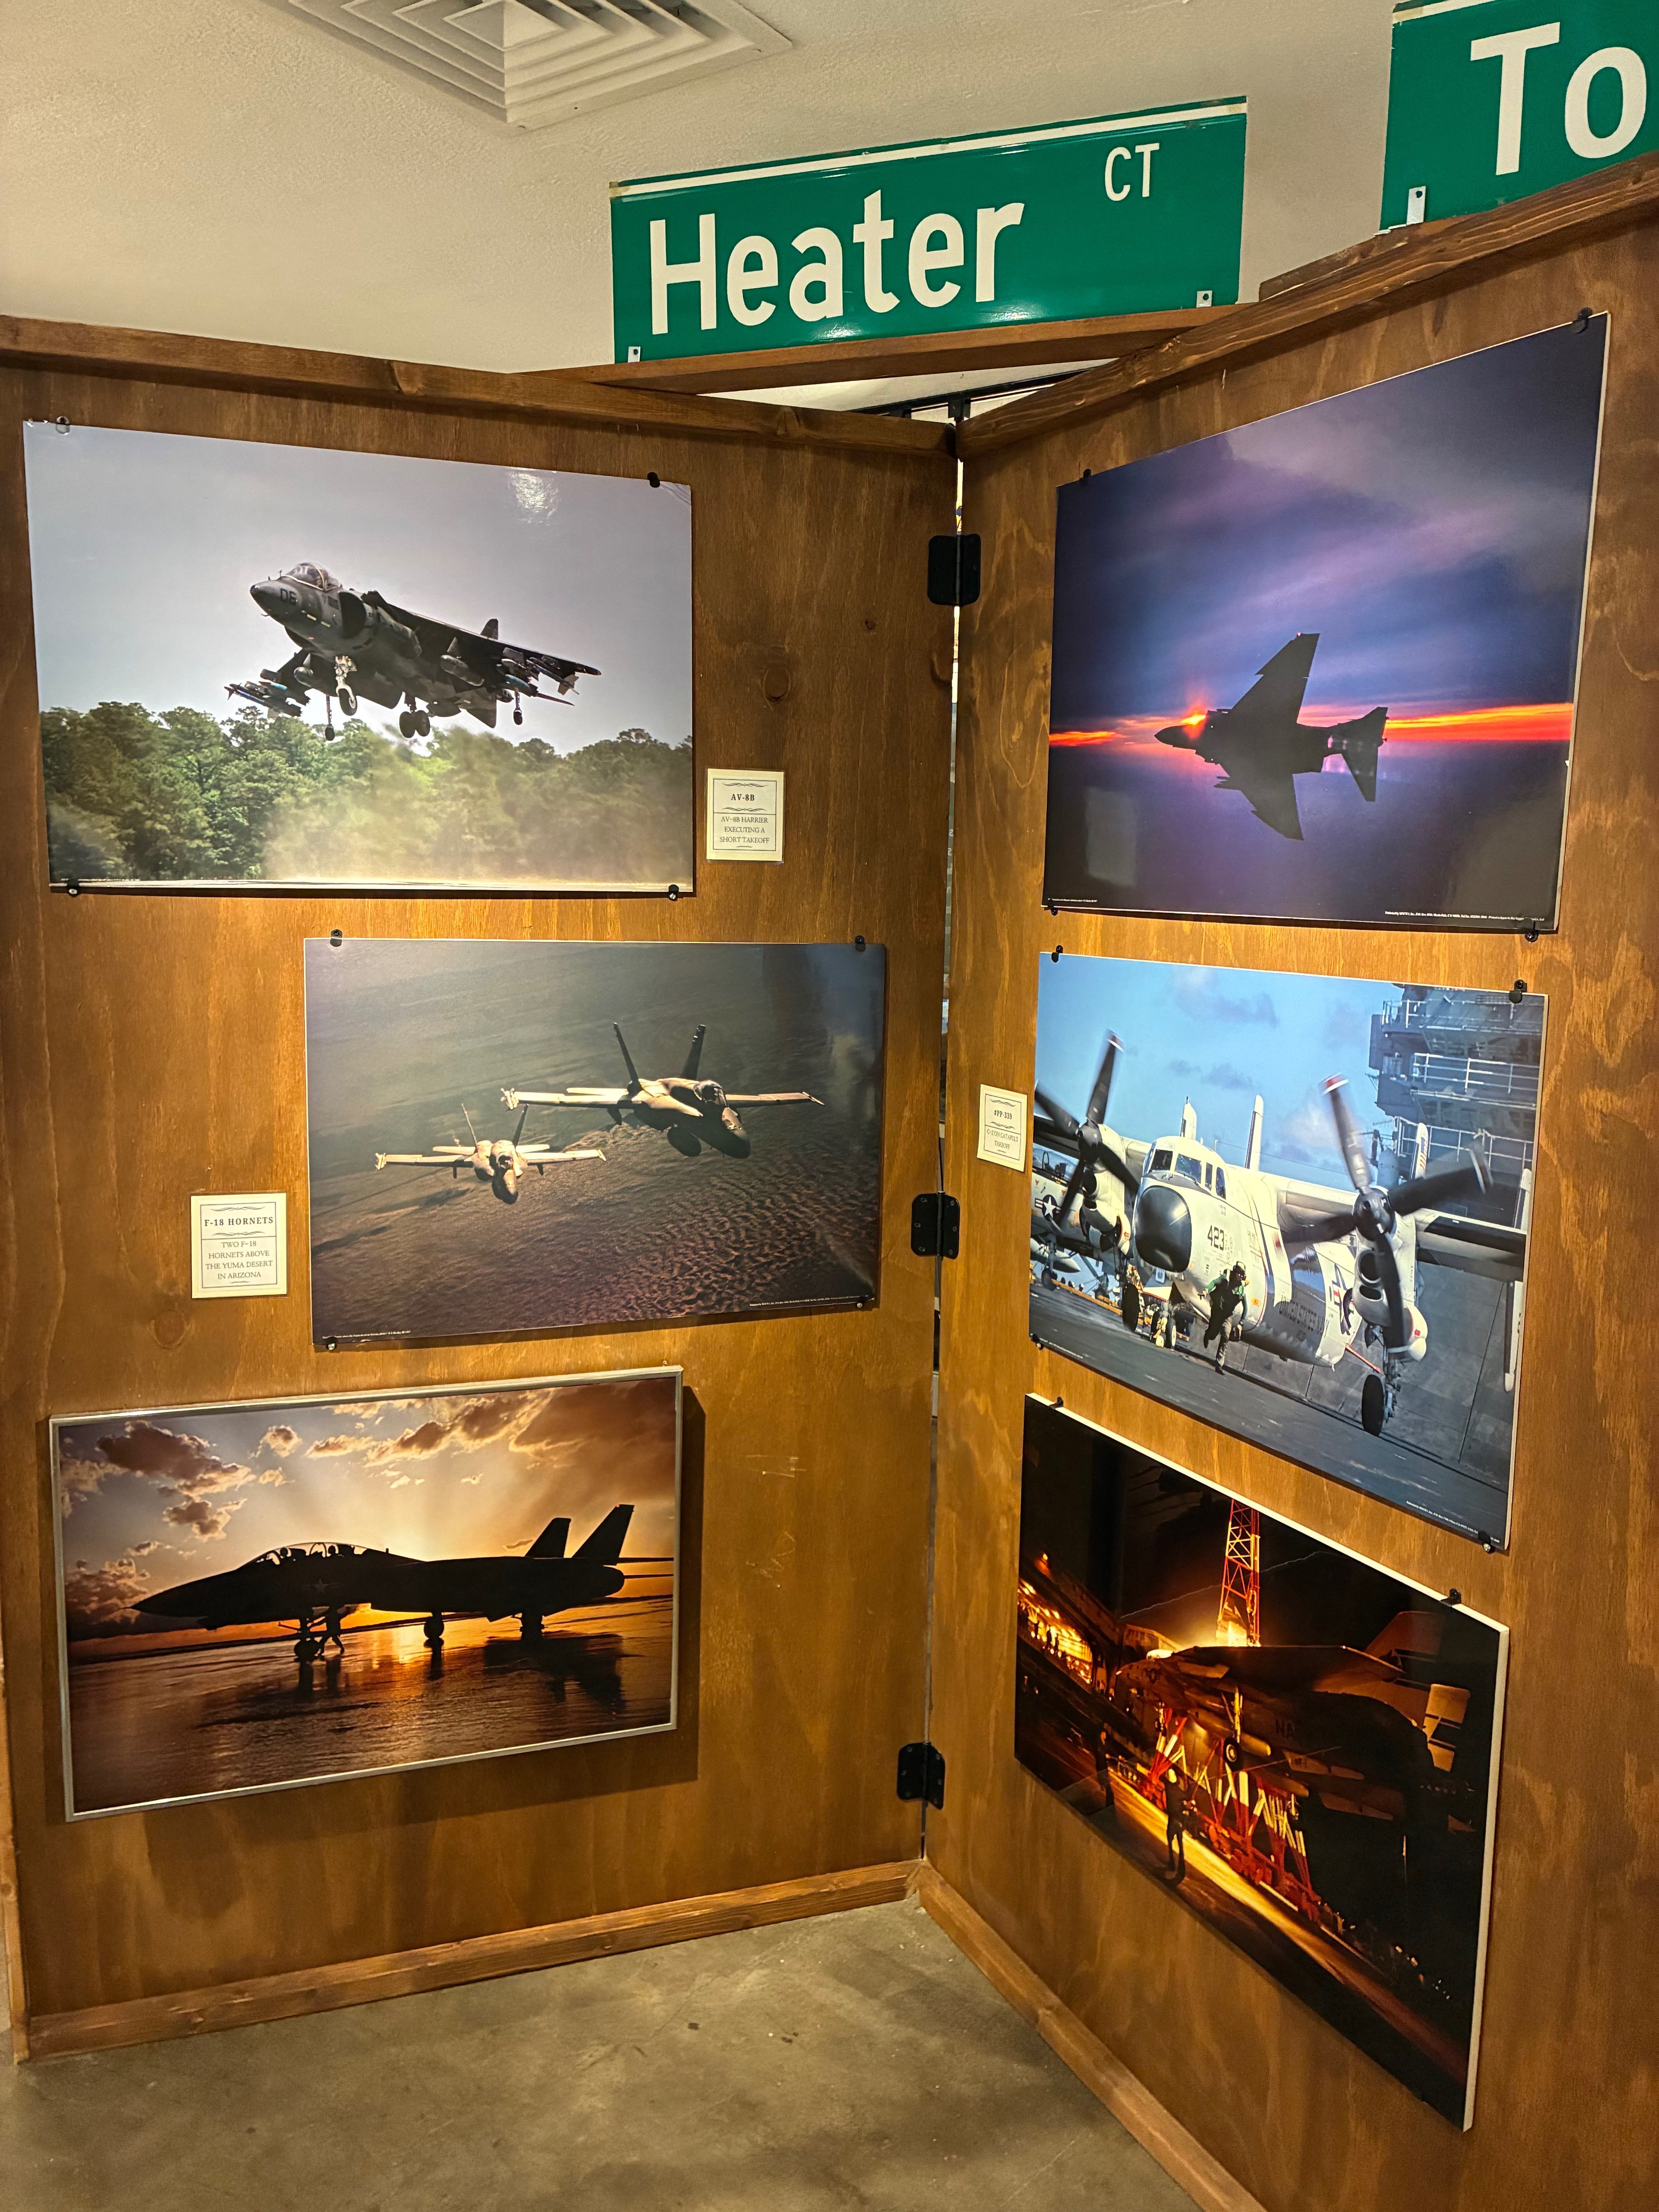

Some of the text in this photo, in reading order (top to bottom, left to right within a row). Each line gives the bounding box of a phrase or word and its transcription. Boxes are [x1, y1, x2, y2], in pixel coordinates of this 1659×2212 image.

[1470, 22, 1647, 175] To
[650, 143, 1160, 335] Heater CT
[994, 1110, 1012, 1120] #PP-339
[1000, 1132, 1018, 1142] CATAPULT
[994, 1140, 1010, 1149] TAKEOFF
[228, 1217, 273, 1226] HORNETS
[1207, 1225, 1224, 1251] 423
